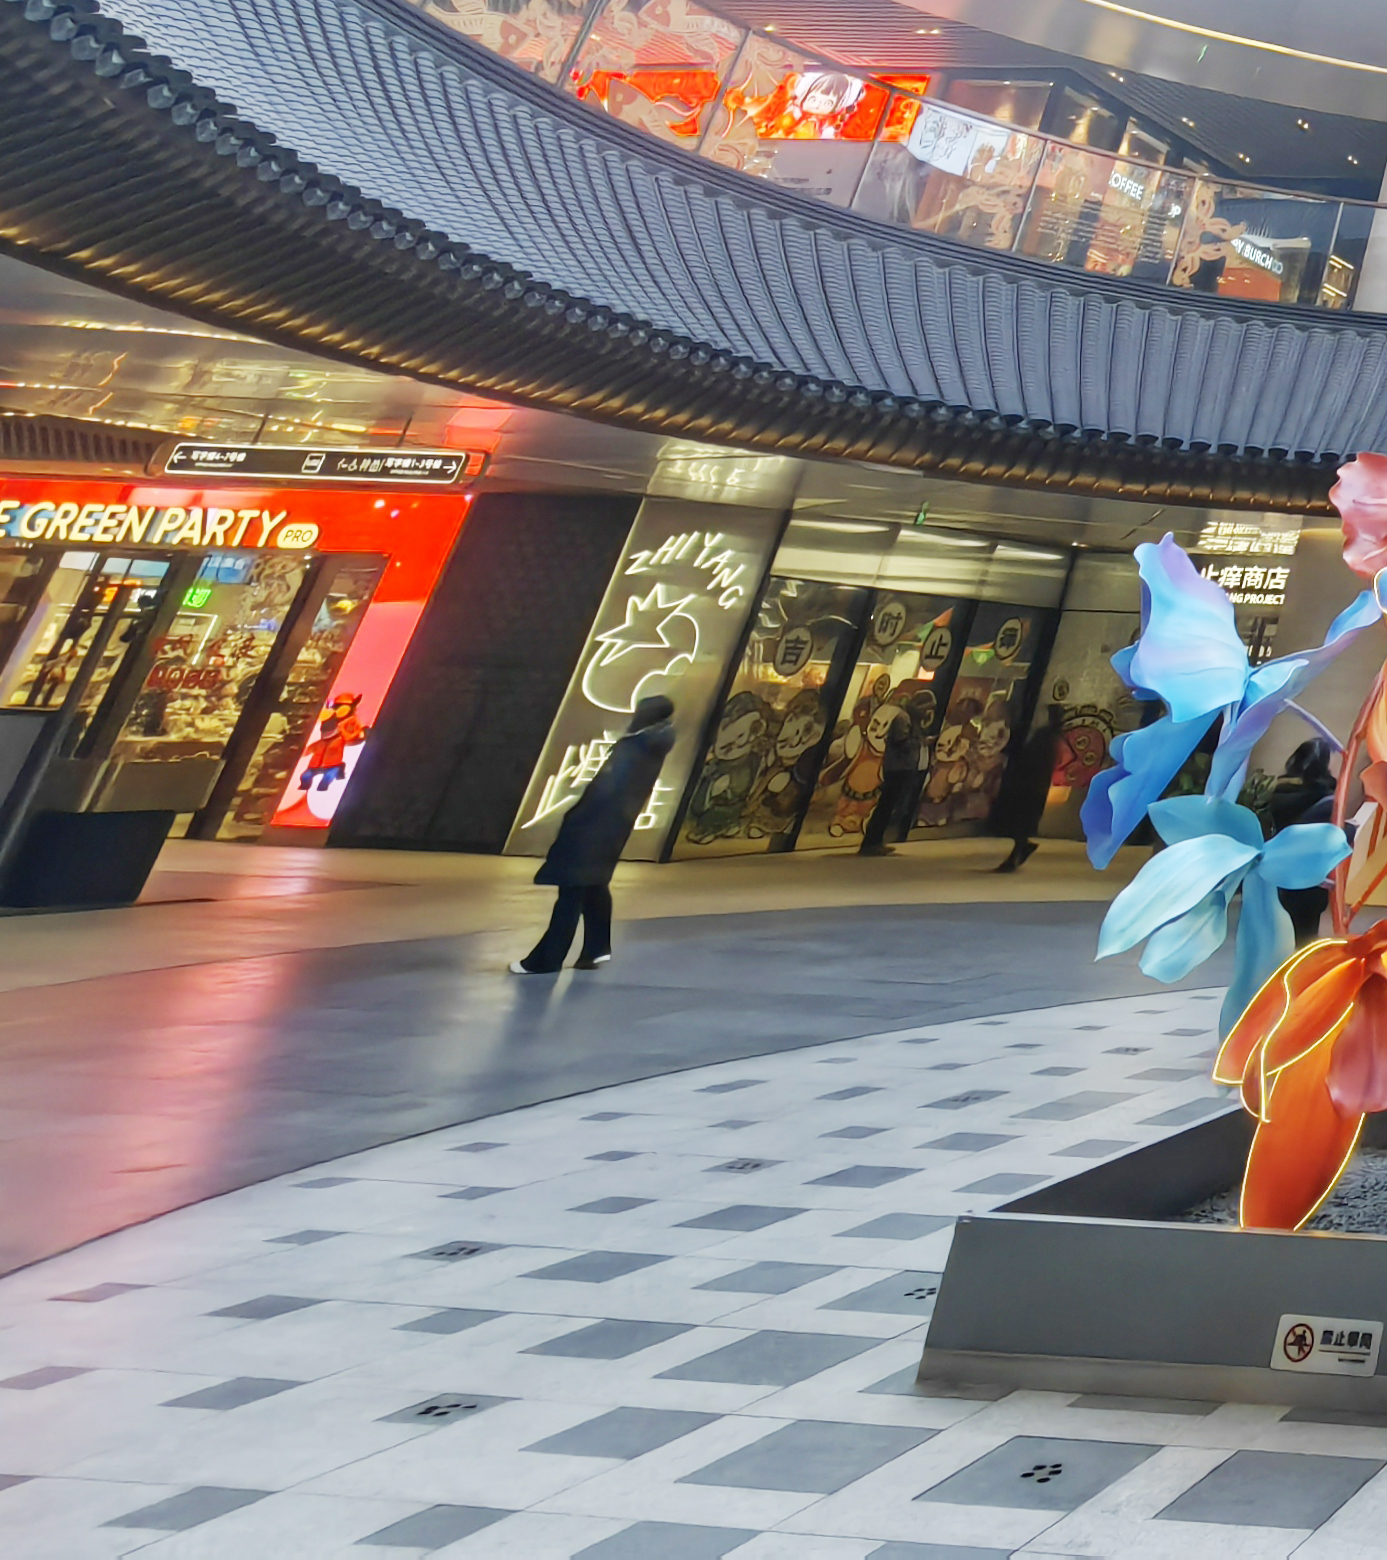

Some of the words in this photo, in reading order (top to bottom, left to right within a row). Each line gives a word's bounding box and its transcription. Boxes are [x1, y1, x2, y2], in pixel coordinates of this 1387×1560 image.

[1244, 243, 1273, 270] BURCH
[19, 501, 156, 543] GREEN
[152, 506, 287, 548] PARTY
[283, 528, 314, 543] PRO
[624, 531, 746, 609] ZHIYANG
[1243, 593, 1286, 605] PROJECT
